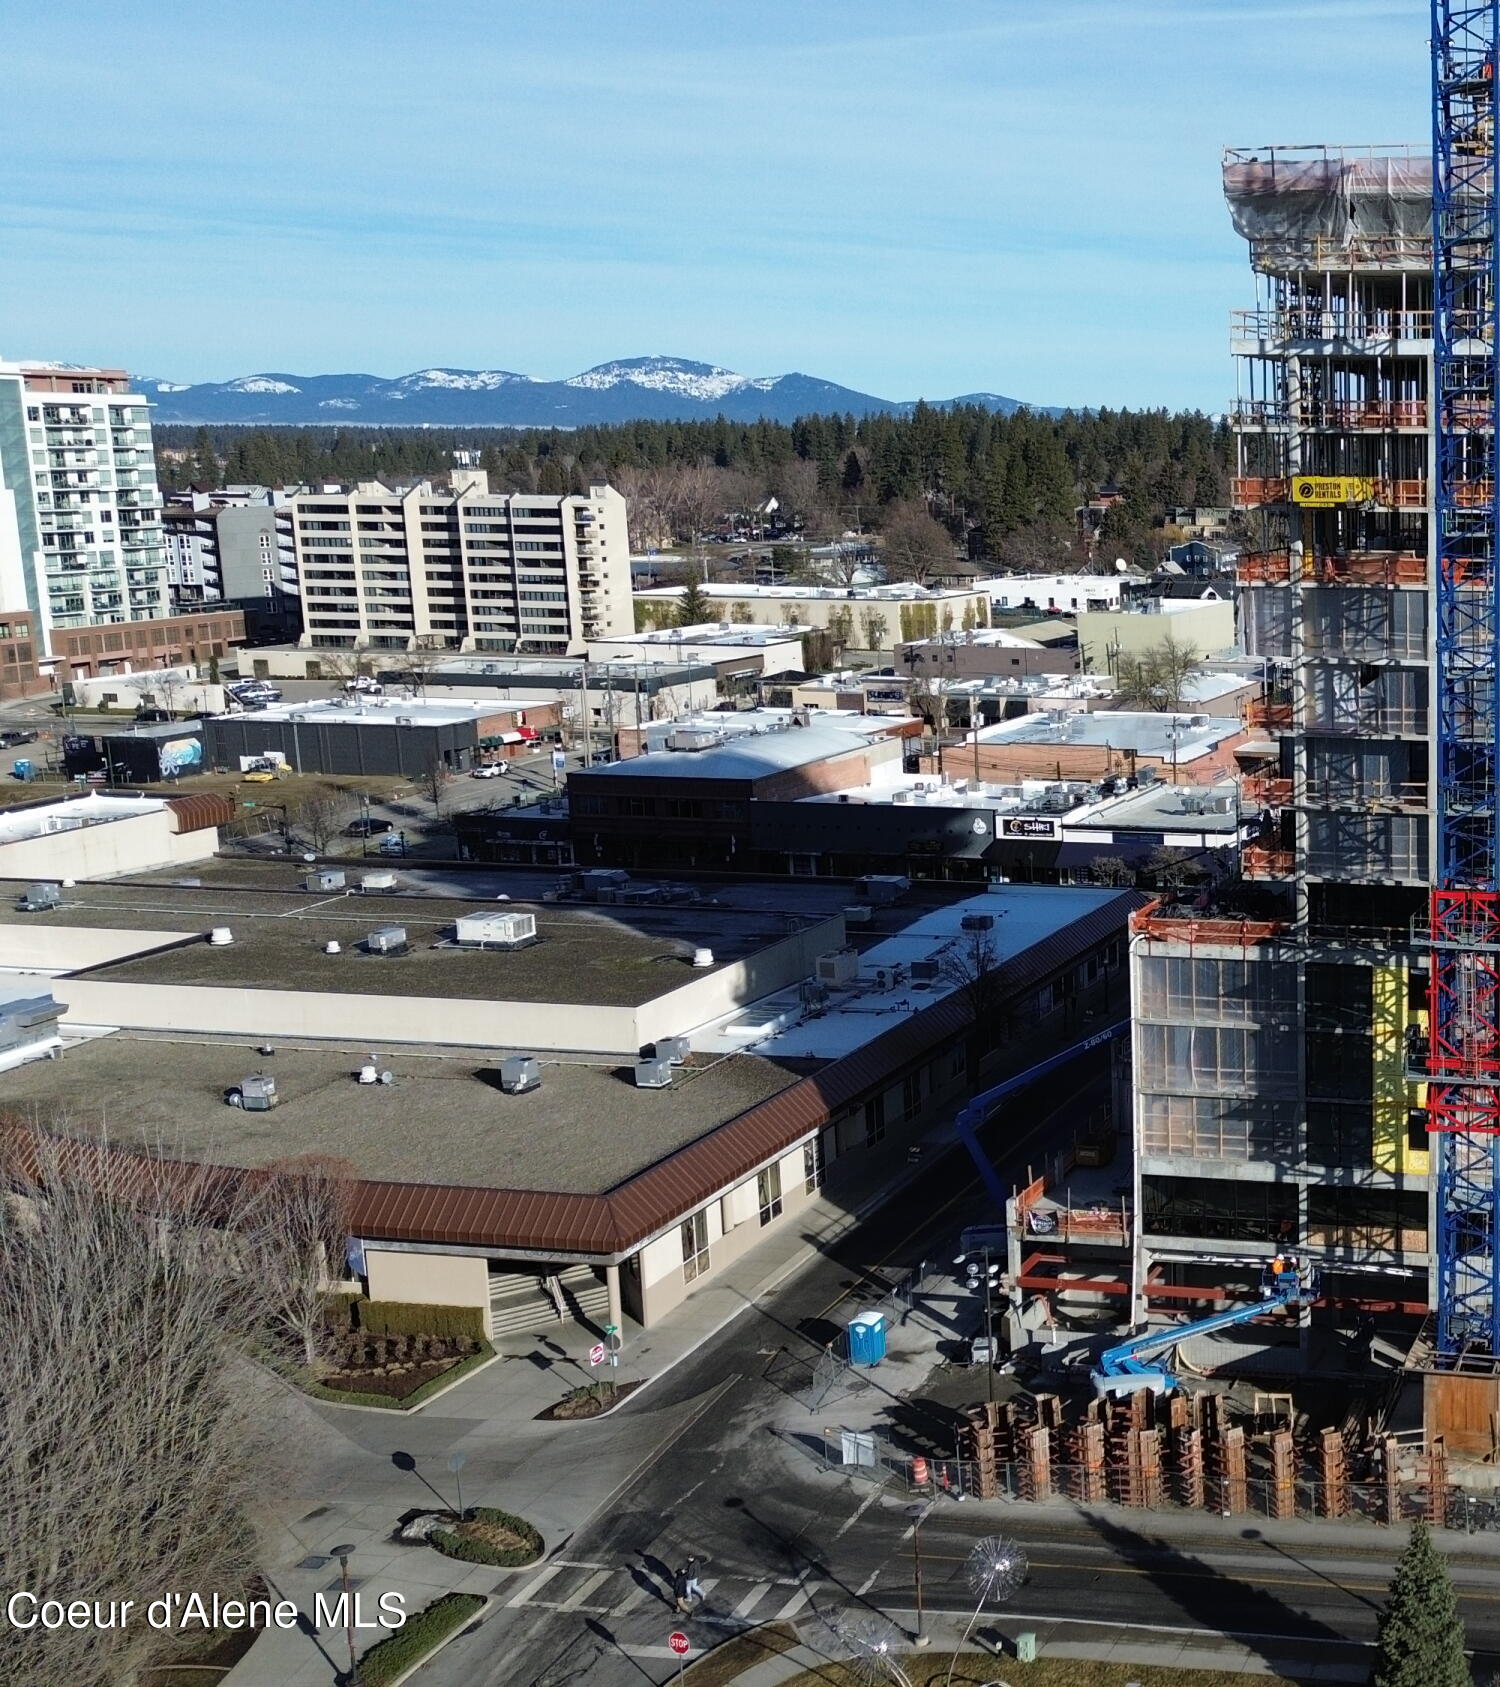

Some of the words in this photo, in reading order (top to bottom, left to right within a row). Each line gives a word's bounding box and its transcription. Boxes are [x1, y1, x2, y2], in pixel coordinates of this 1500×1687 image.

[1315, 482, 1341, 490] PRESTON
[1315, 490, 1341, 499] RENTALS
[670, 1637, 688, 1648] STOP
